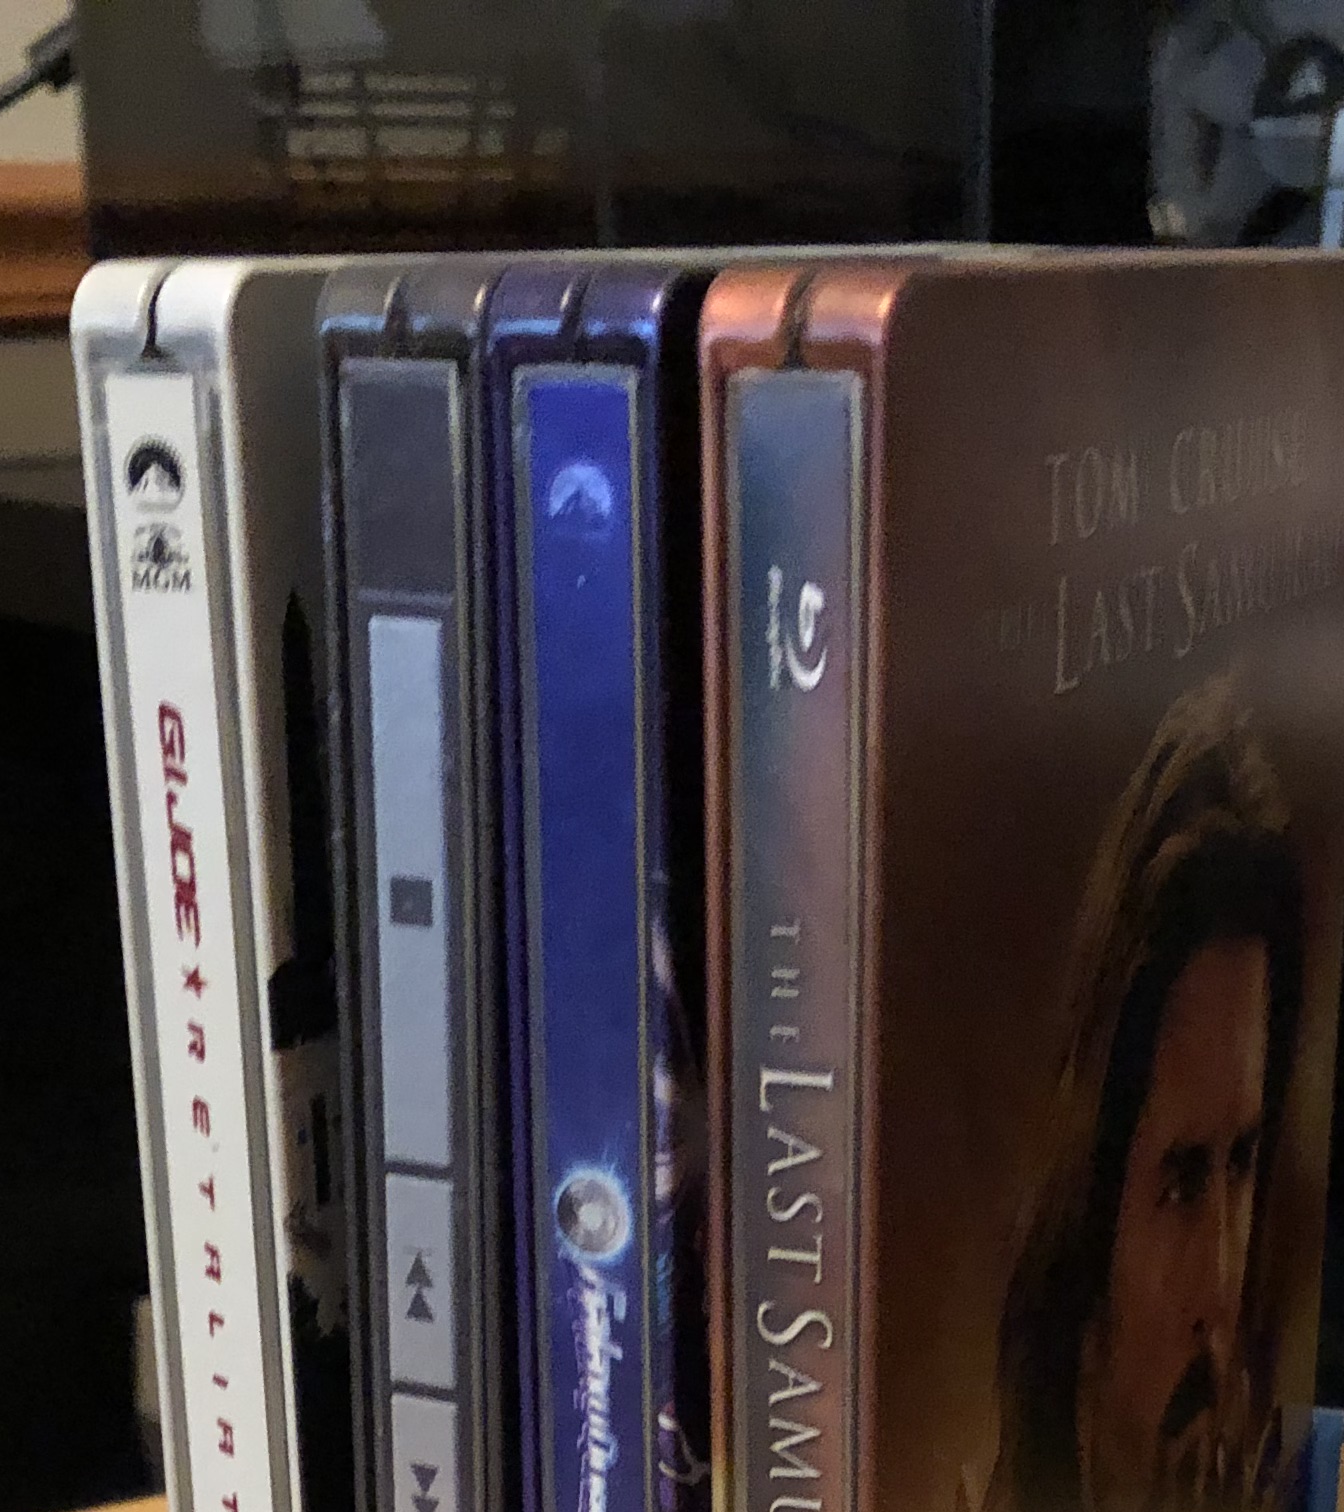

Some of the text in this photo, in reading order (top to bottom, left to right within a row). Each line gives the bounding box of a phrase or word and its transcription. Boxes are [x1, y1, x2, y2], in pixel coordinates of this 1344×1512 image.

[1044, 444, 1141, 547] TOM
[131, 567, 192, 592] MGM
[1053, 565, 1163, 694] LAST
[768, 917, 802, 1045] THE
[758, 1065, 836, 1285] LAST
